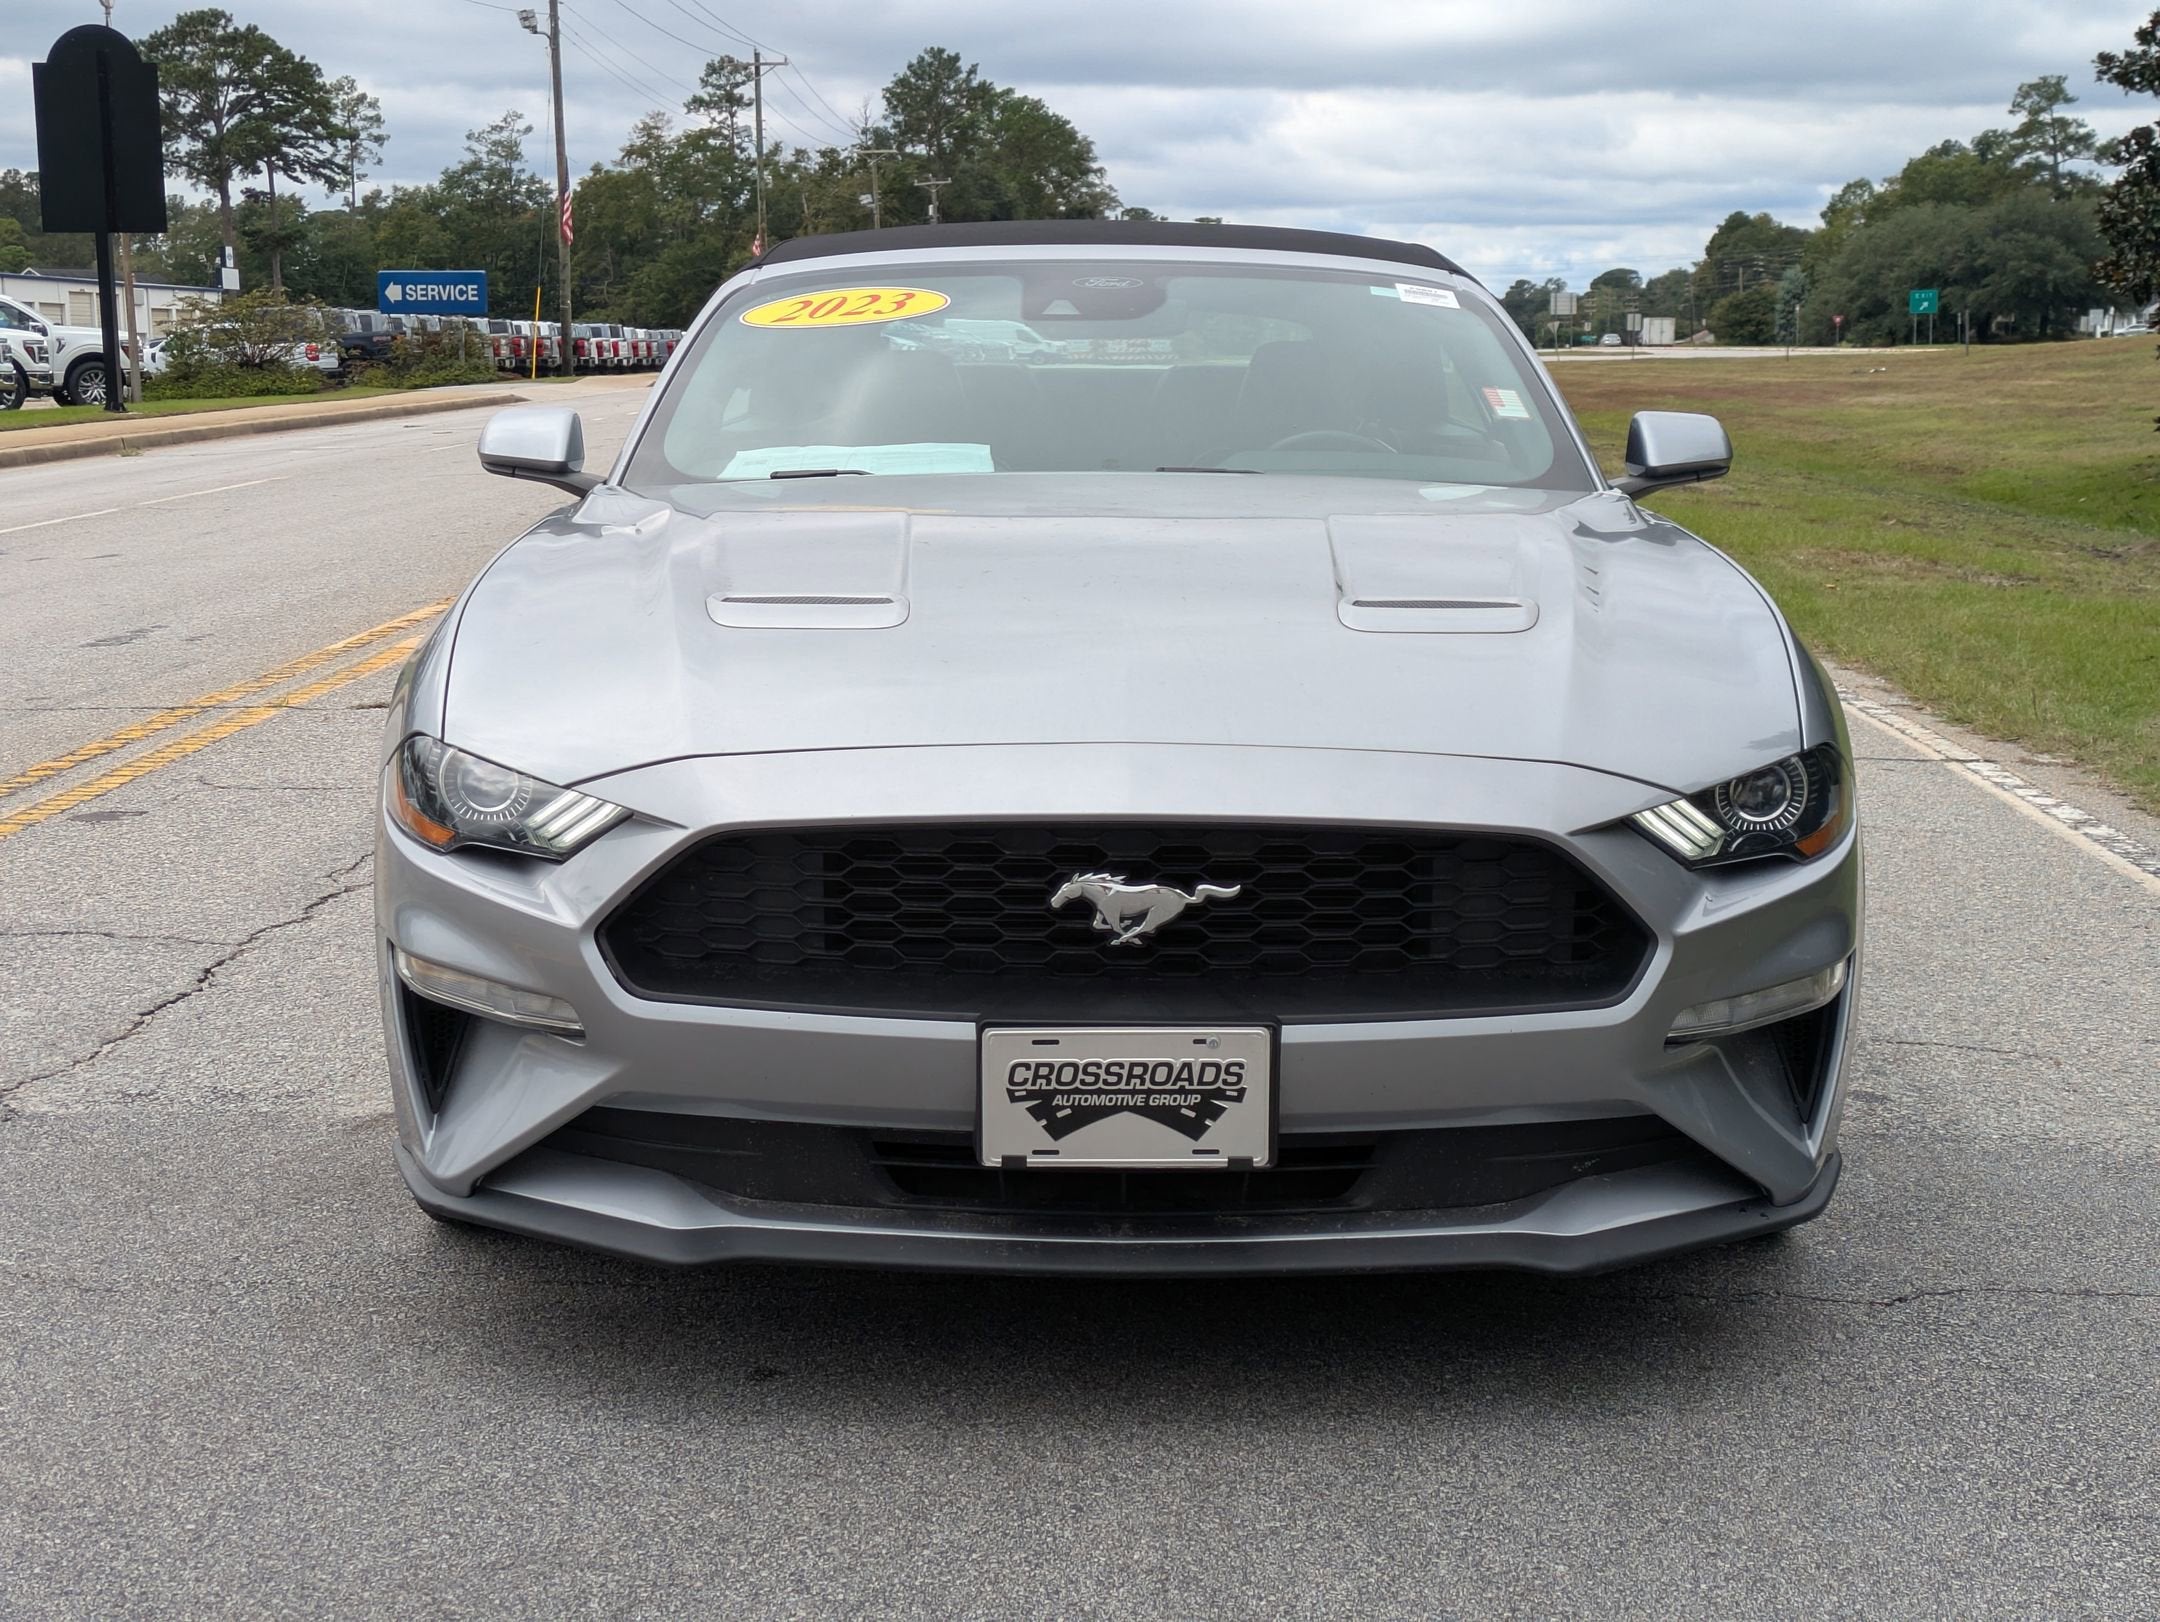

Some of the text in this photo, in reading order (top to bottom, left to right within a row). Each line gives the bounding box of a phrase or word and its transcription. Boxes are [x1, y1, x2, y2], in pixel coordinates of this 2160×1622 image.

[1084, 278, 1132, 288] Ford
[405, 284, 479, 301] SERVICE
[770, 292, 916, 323] 2023
[1007, 1061, 1246, 1088] CROSSROADS
[1052, 1094, 1202, 1106] AUTOMOTIVE GROUP
